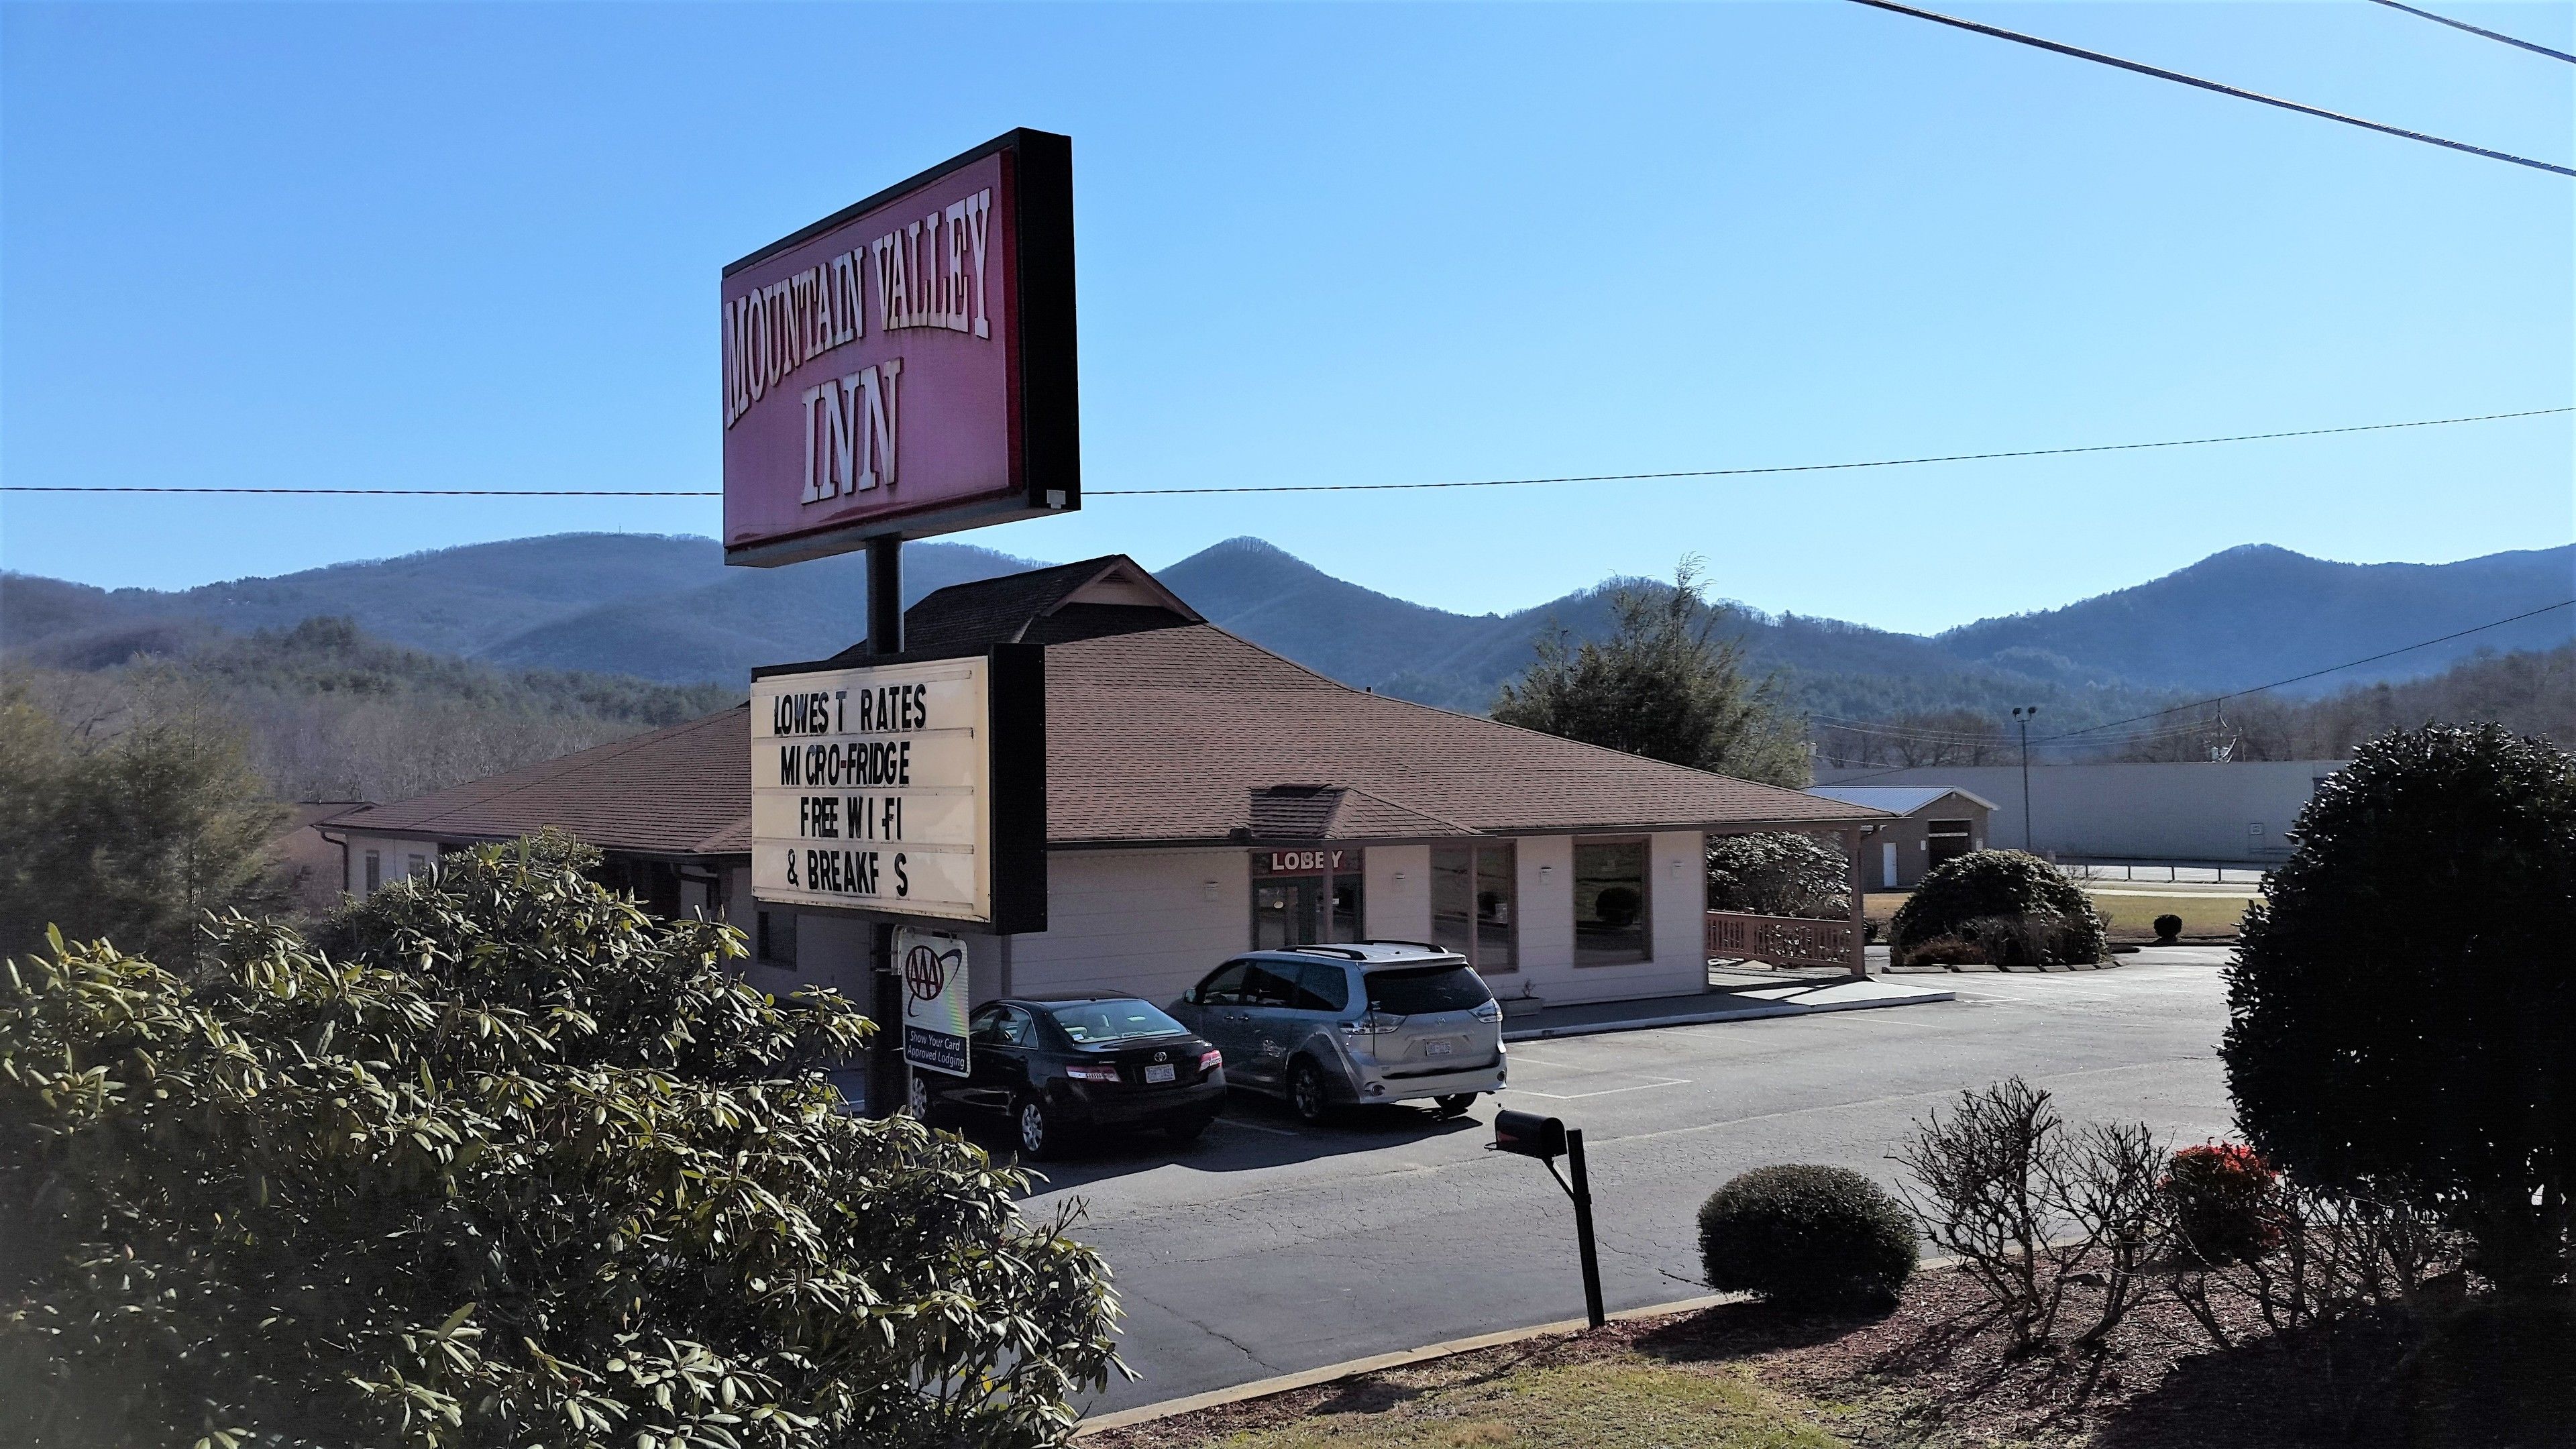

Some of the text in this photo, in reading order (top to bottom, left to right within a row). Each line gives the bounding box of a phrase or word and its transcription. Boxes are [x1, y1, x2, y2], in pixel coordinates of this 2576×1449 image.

[725, 188, 990, 429] MOUNTAIN VALLEY
[801, 357, 903, 504] INN
[861, 684, 926, 732] RATES
[800, 796, 839, 839] FREE
[787, 849, 799, 888] &
[907, 946, 943, 1000] AAA
[907, 1044, 965, 1070] Approved Lodging
[910, 1030, 960, 1051] Show Your Card
